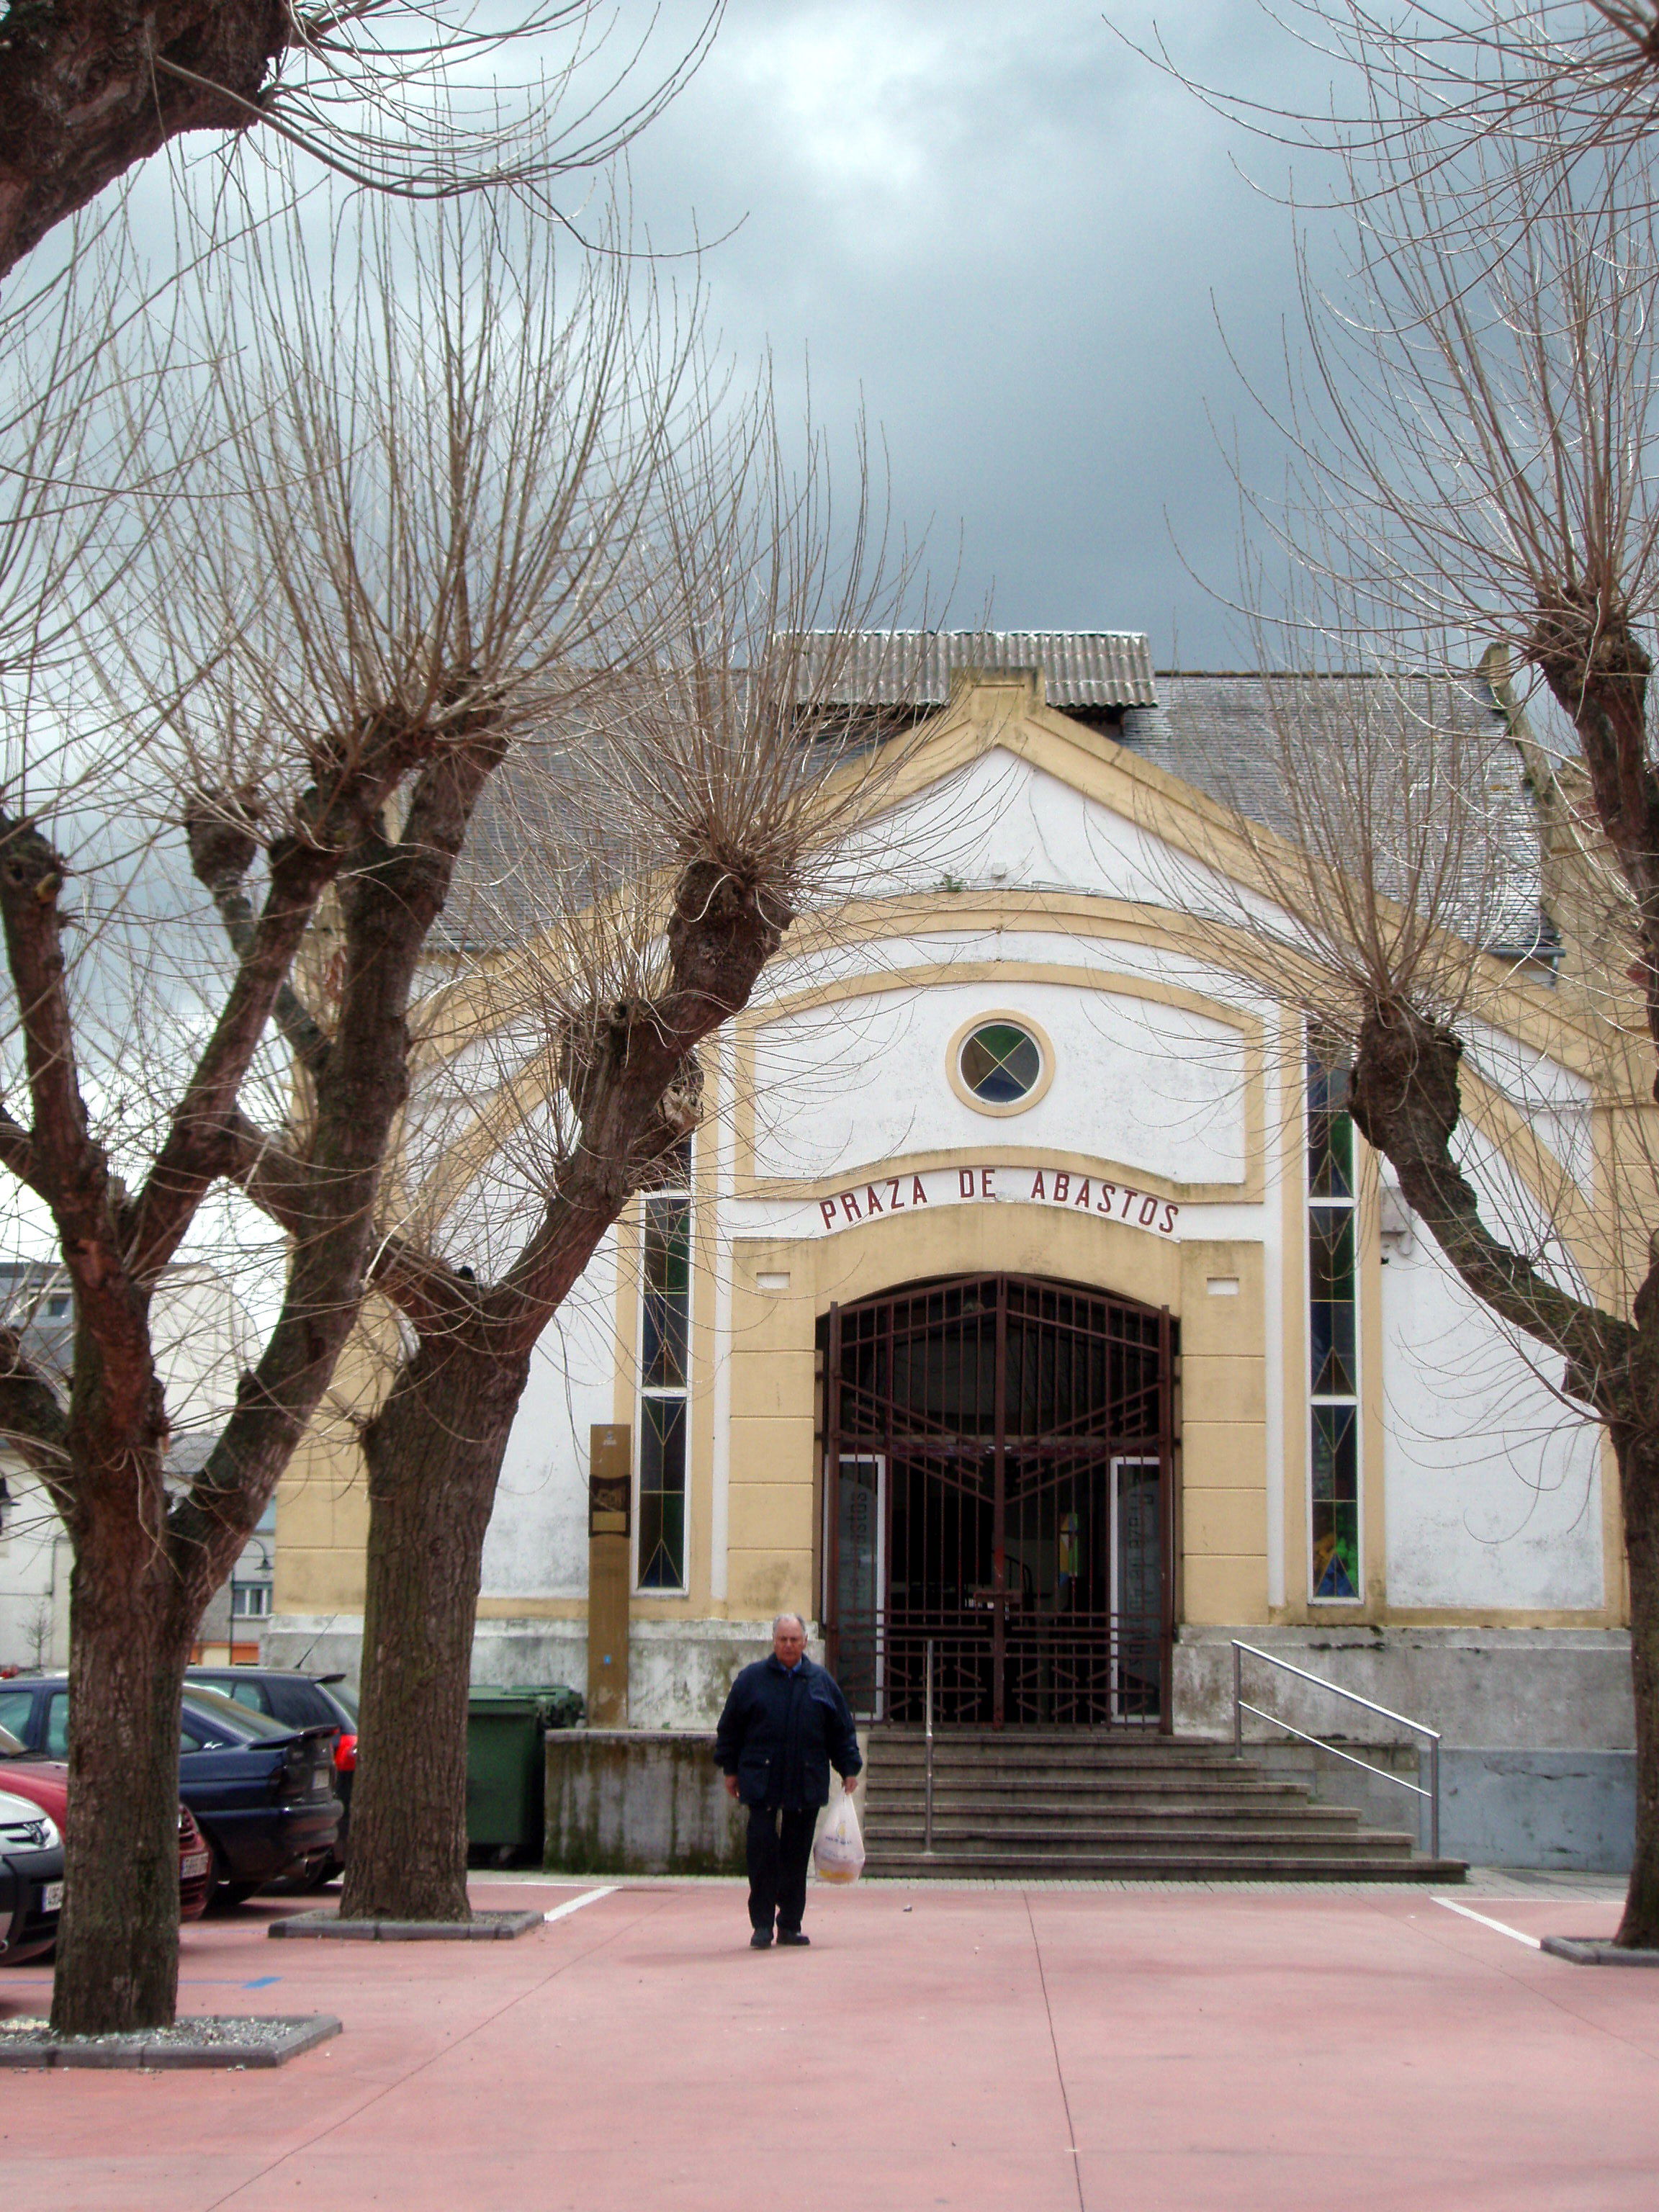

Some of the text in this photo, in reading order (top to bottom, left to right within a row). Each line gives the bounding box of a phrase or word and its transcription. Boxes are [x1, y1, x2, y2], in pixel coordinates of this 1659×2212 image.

[819, 1169, 1179, 1233] PRAZA DE ABASTOS
